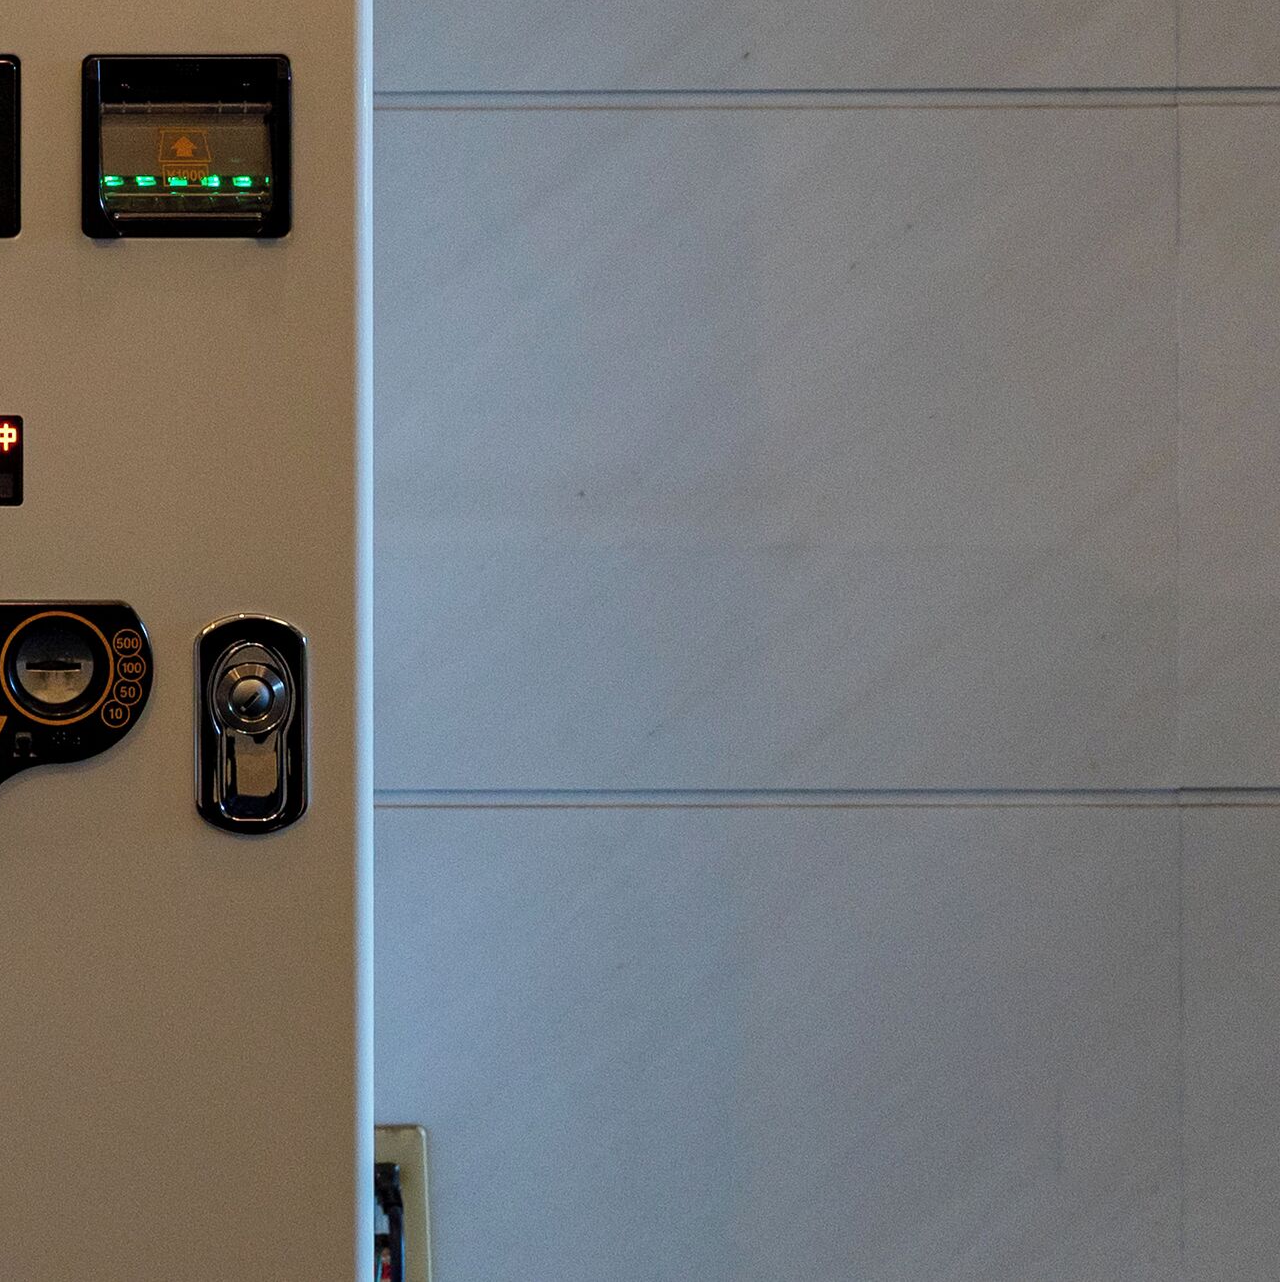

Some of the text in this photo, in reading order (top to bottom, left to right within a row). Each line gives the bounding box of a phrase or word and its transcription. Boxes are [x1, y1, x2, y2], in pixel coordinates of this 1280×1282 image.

[116, 637, 139, 650] 500
[122, 662, 142, 675] 100
[120, 686, 137, 699] 50
[109, 707, 123, 720] 10
